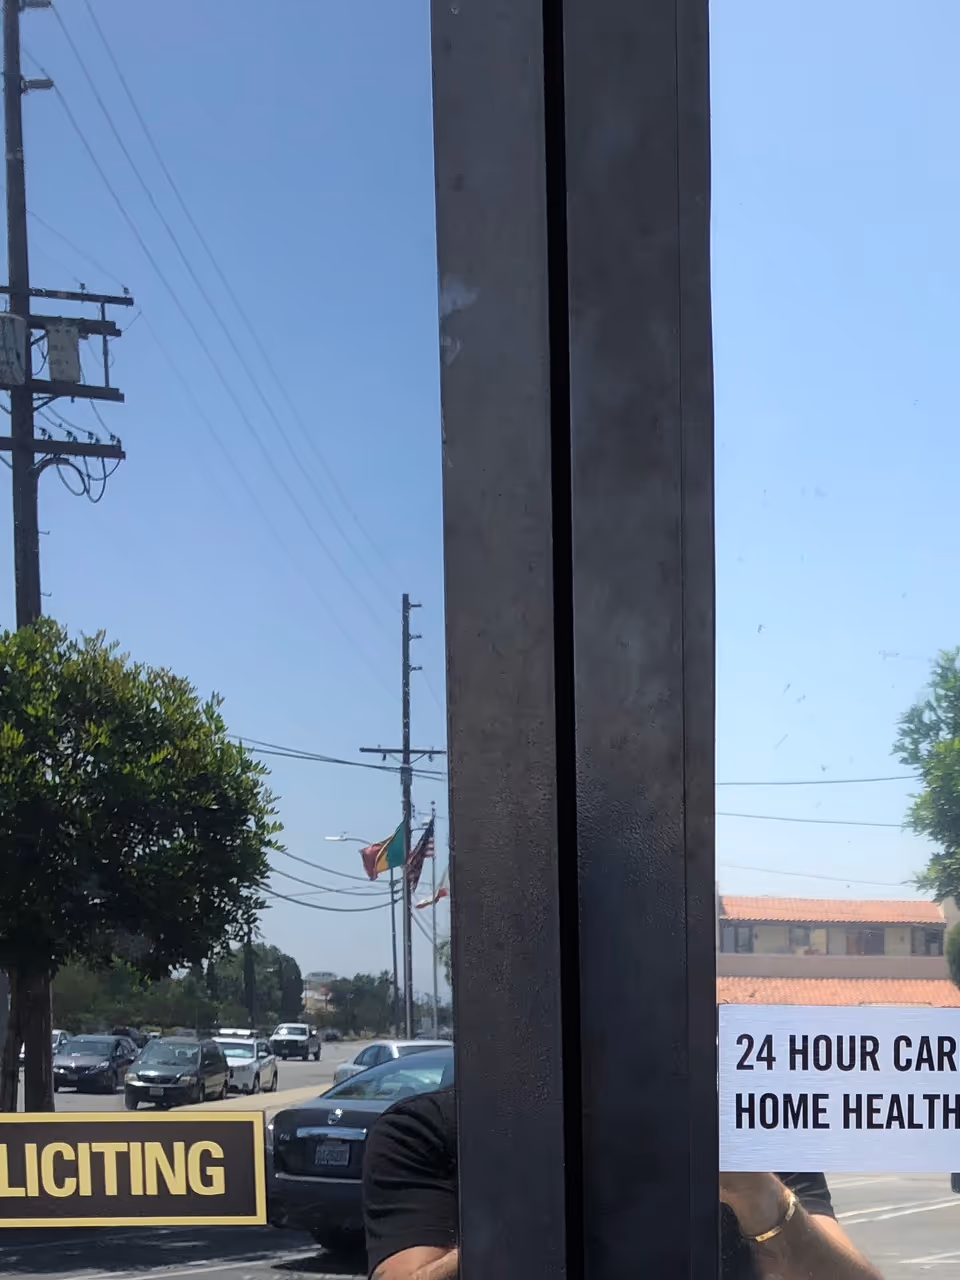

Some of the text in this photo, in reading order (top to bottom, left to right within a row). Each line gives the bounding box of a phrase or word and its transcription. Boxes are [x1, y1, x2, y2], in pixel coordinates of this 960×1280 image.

[736, 1034, 776, 1071] 24
[788, 1034, 880, 1072] HOUR
[736, 1093, 830, 1129] HOME
